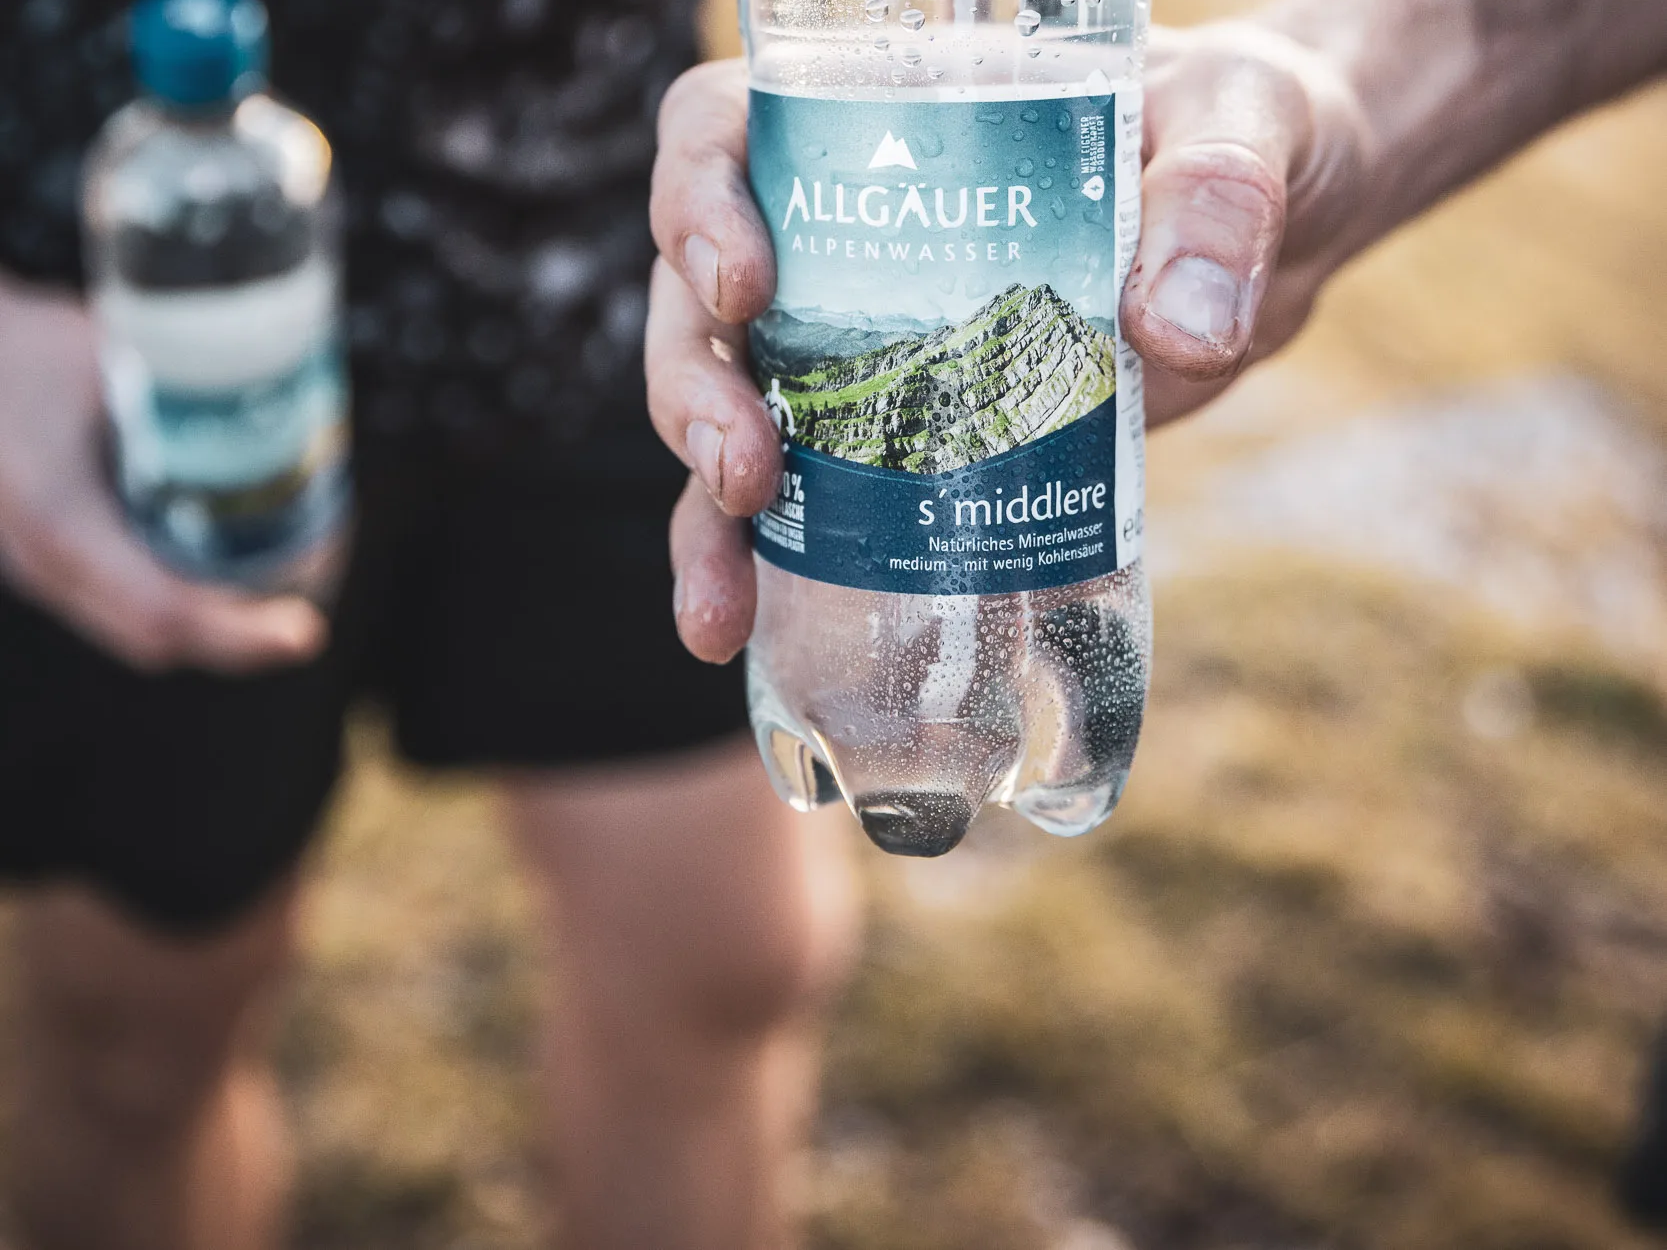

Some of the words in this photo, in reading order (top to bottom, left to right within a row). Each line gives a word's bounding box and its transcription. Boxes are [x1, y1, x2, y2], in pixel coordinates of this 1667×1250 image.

[1081, 116, 1090, 154] EIGENER
[1089, 116, 1098, 174] WASSERKRAFT
[1097, 115, 1105, 172] PRODUZIERT
[1081, 158, 1089, 174] MIT
[782, 176, 1038, 230] ALLGÄUER
[792, 234, 1021, 262] ALPENWASSER
[929, 536, 1014, 552] Natürliches
[1018, 522, 1103, 549] Mineralwasser
[889, 557, 947, 572] medium
[964, 556, 988, 571] mit
[993, 555, 1033, 571] wenig
[1038, 542, 1104, 566] Kohlensäure
